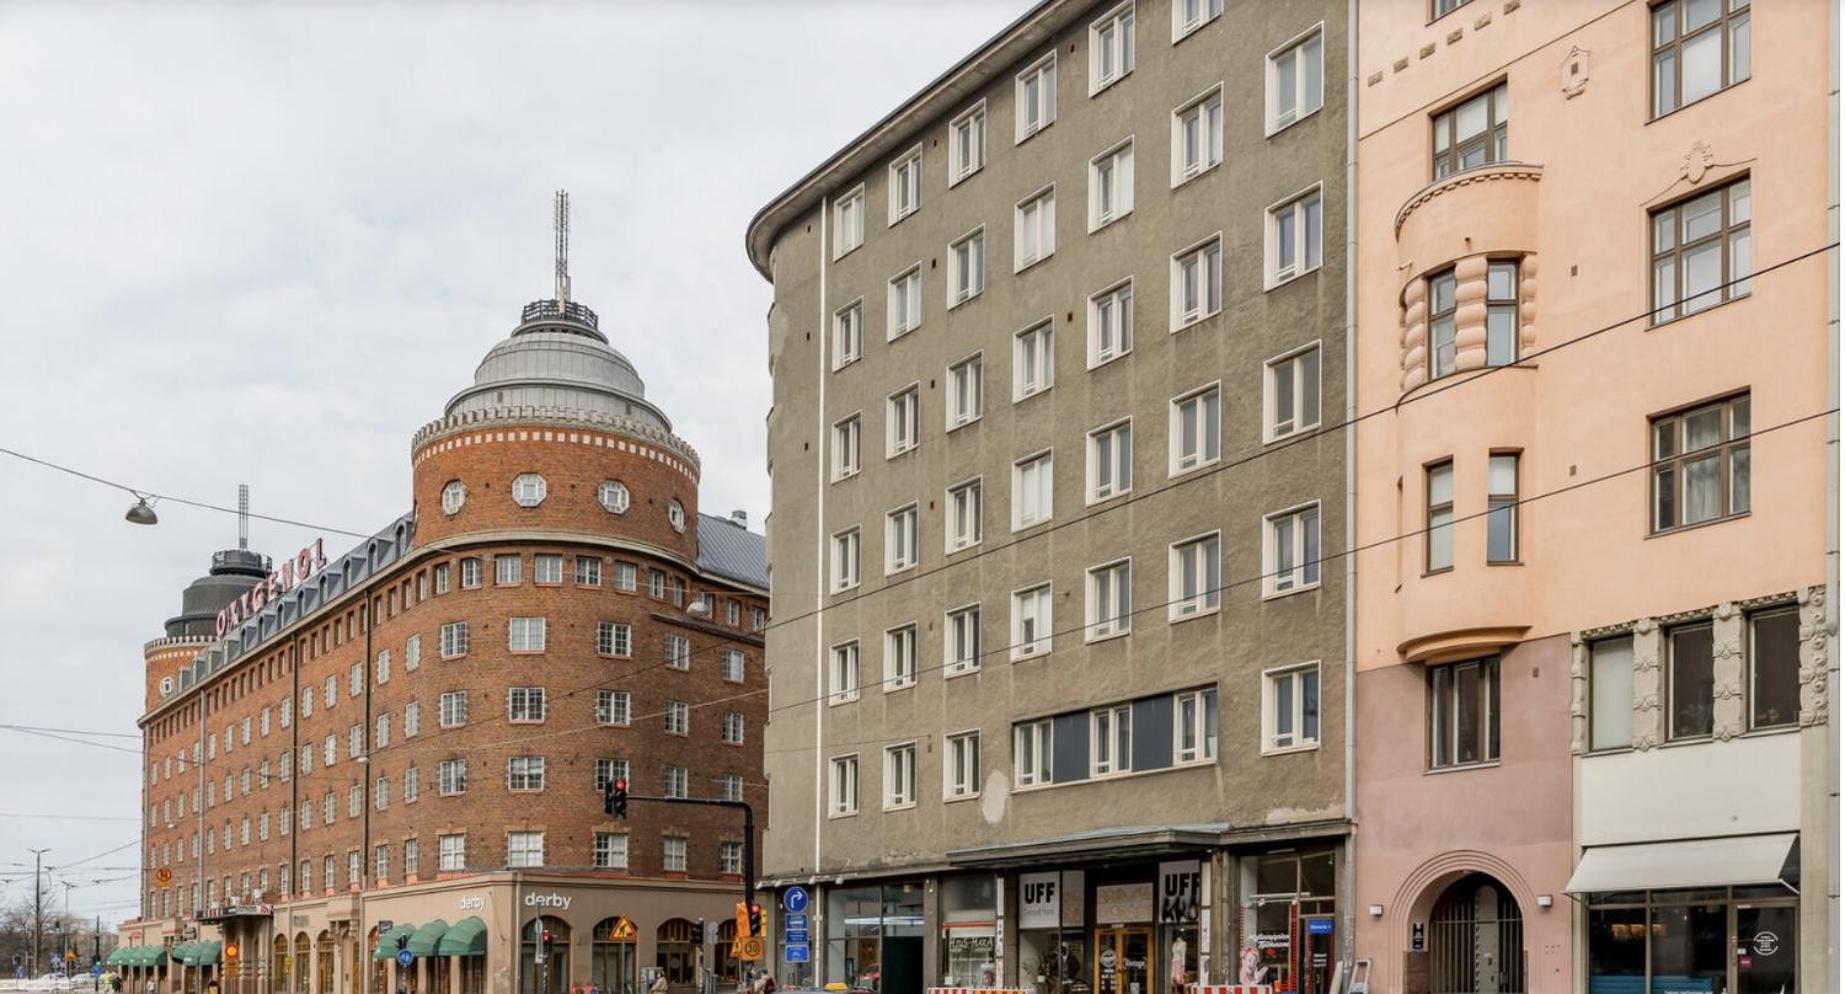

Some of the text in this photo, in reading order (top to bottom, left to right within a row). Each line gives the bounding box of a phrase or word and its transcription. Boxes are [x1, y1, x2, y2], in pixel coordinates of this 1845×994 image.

[216, 537, 327, 637] OXYGENOL
[460, 895, 486, 911] derby
[525, 892, 572, 910] derby
[1024, 882, 1055, 904] UFF
